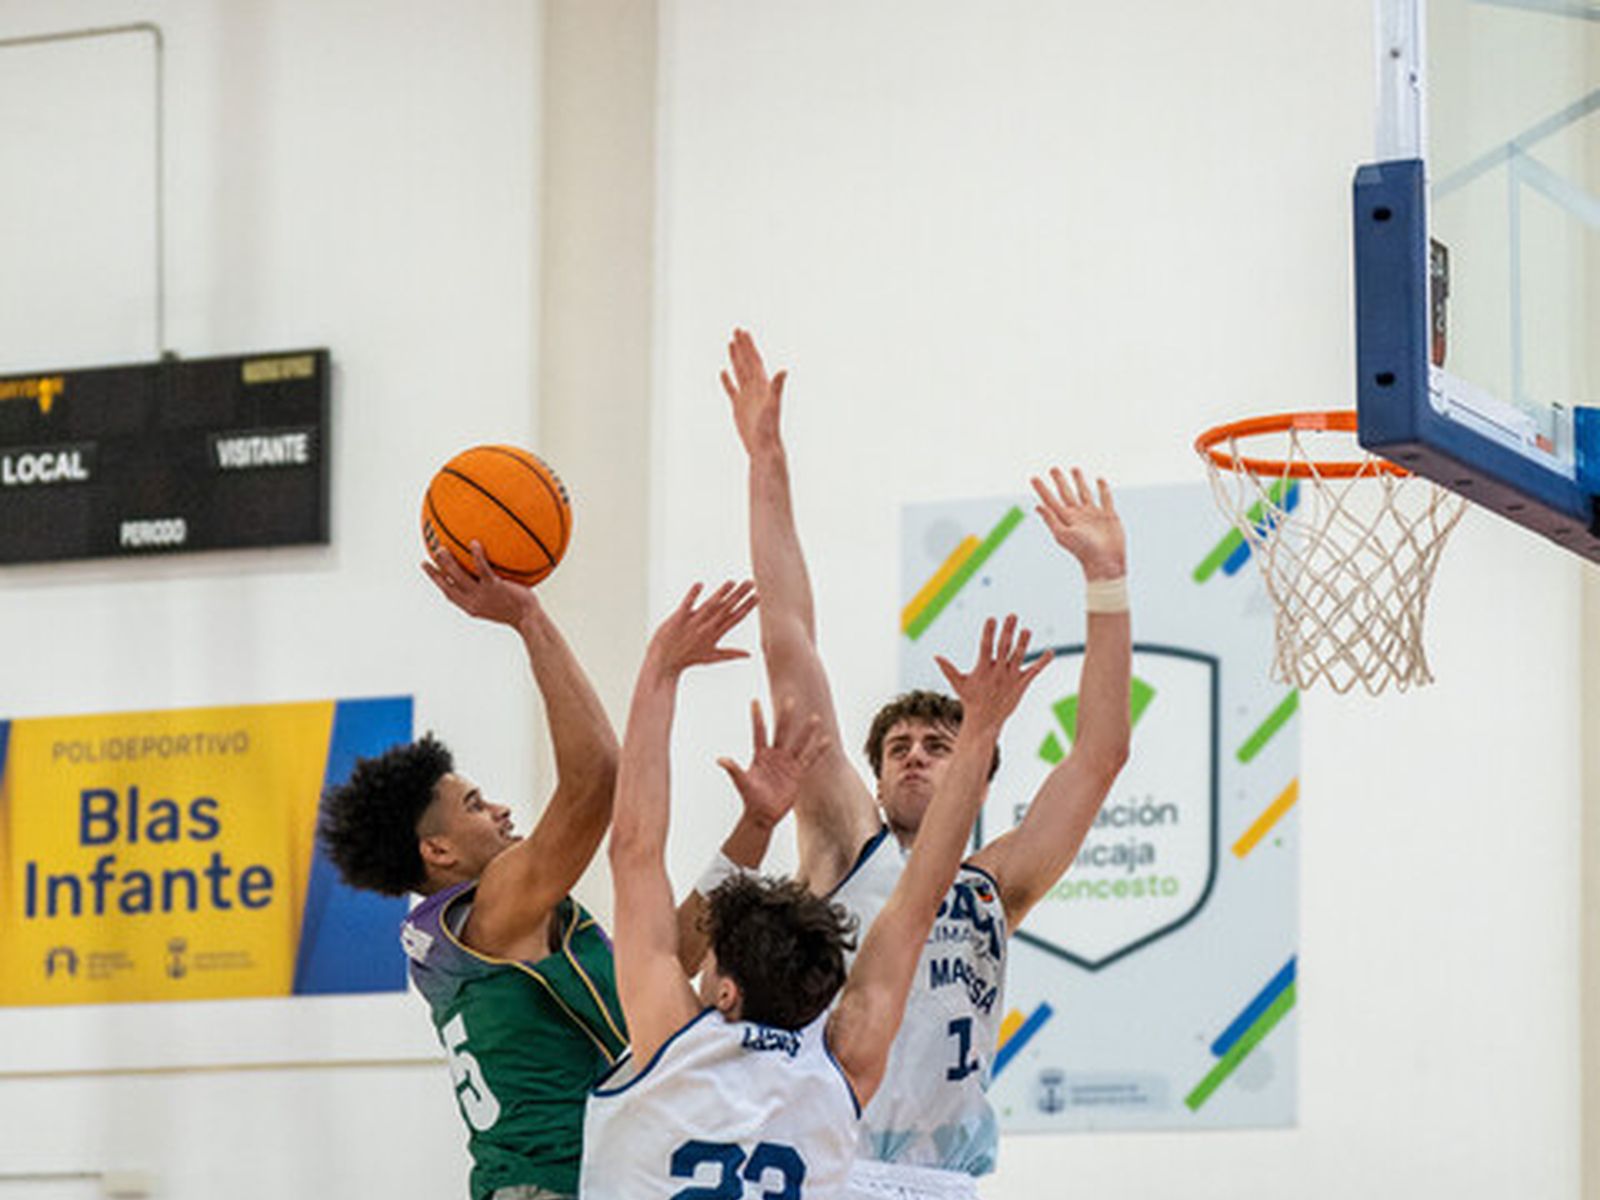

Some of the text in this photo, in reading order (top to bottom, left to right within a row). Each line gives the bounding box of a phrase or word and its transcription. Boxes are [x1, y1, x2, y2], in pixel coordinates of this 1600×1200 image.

[1, 451, 88, 485] LOCAL
[216, 432, 310, 468] VISITANTE
[52, 730, 250, 764] POLIDEPORTIVO
[79, 785, 221, 847] Blas
[1013, 793, 1179, 829] Fación
[25, 851, 275, 919] Infante
